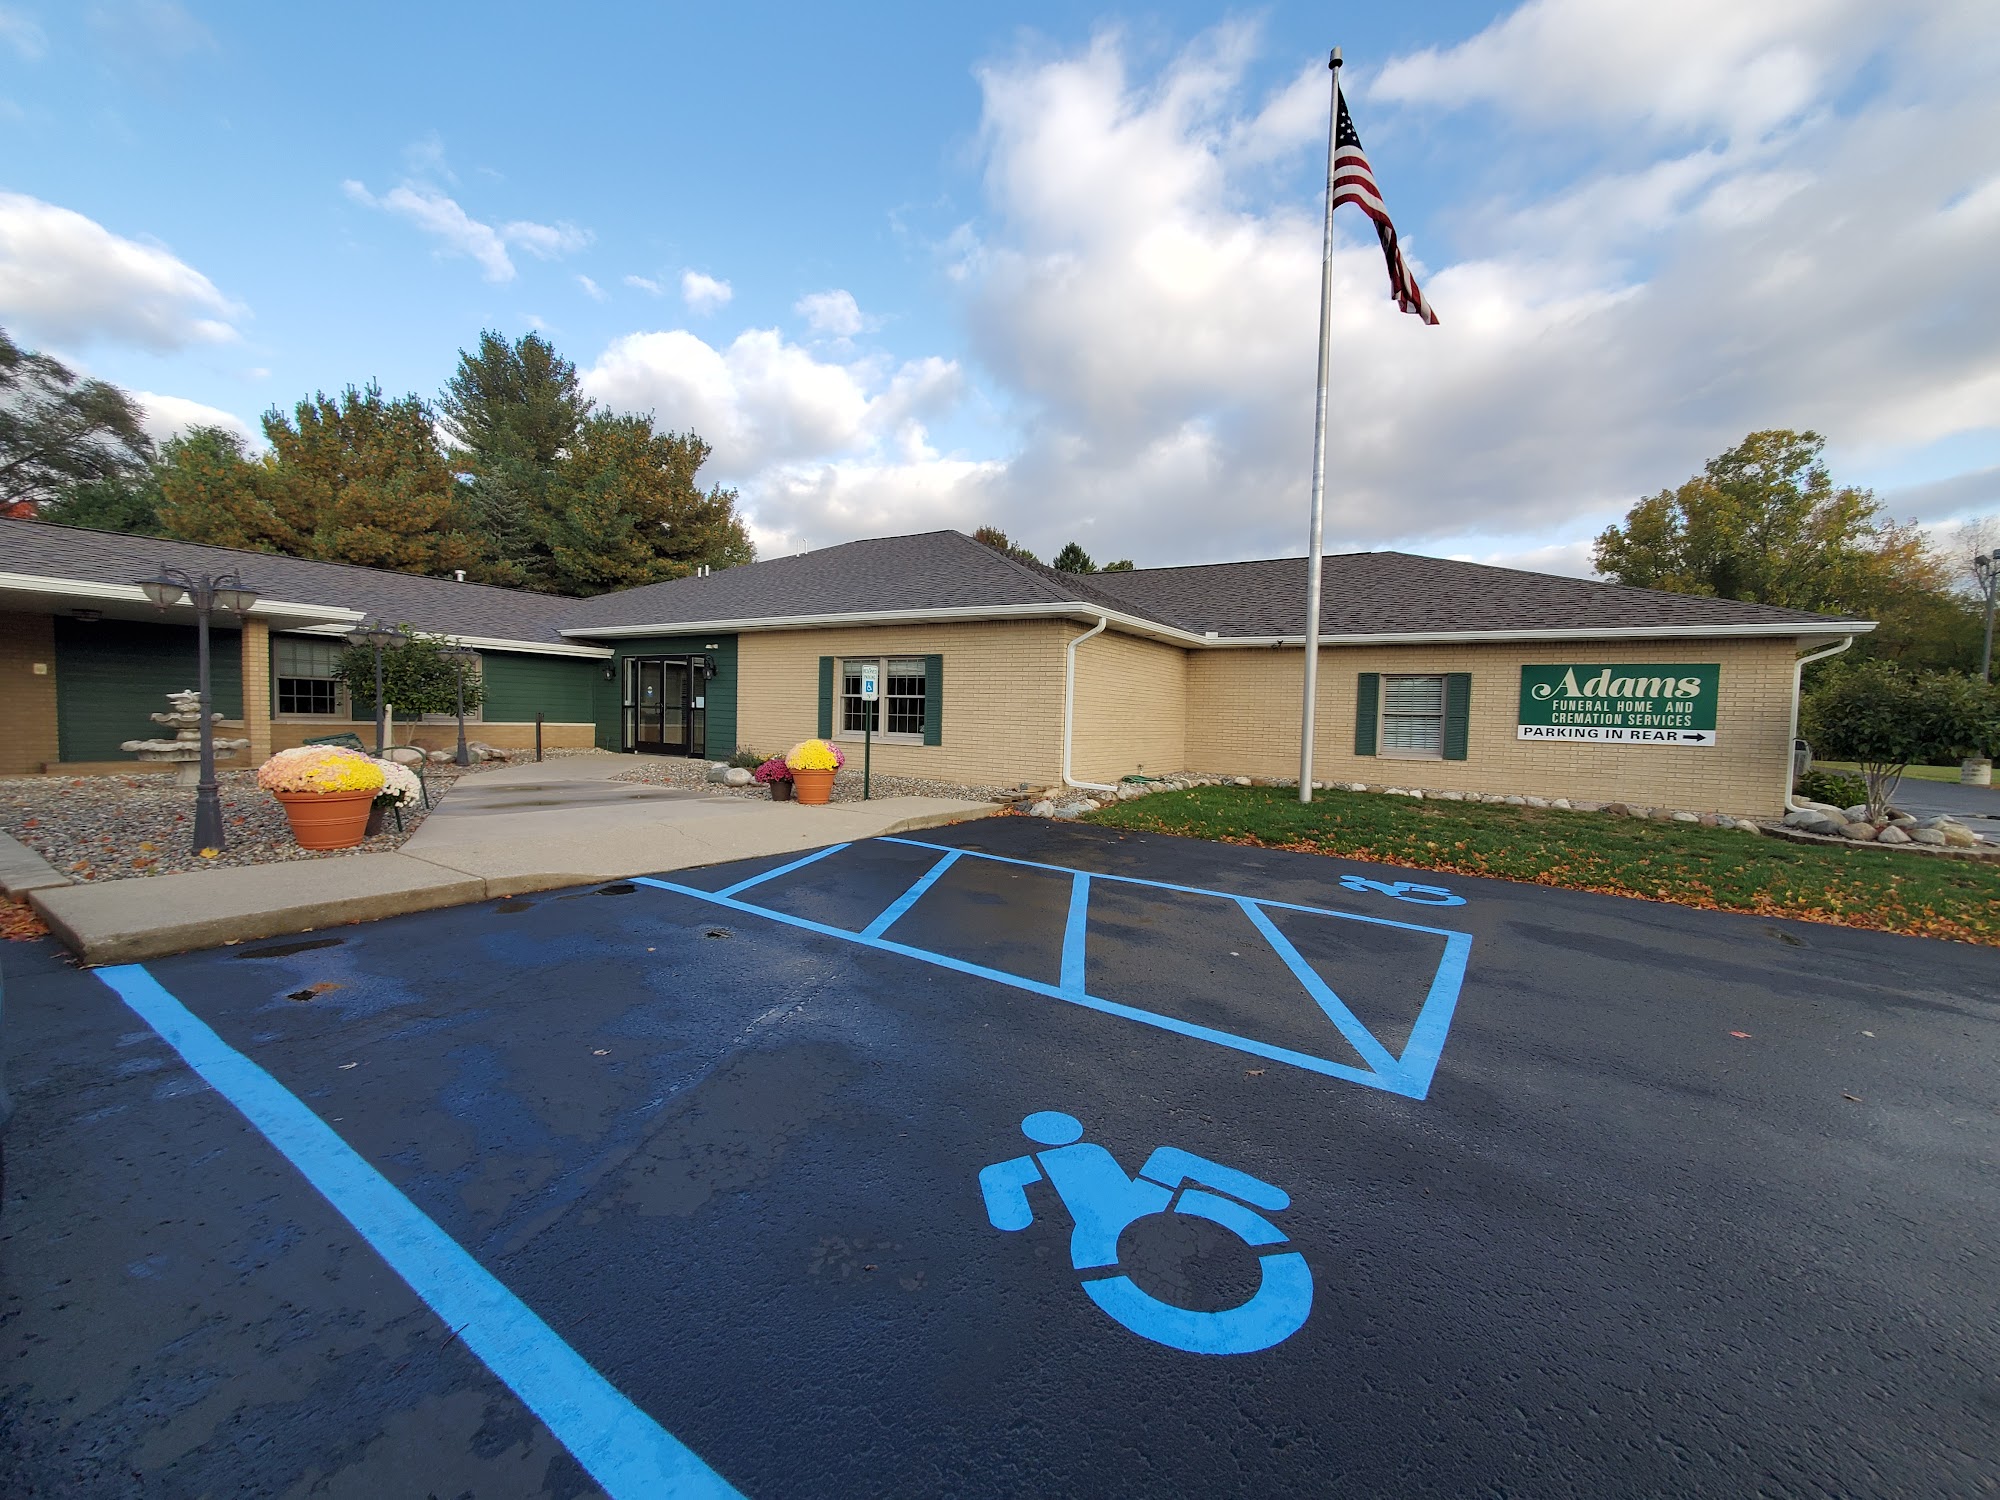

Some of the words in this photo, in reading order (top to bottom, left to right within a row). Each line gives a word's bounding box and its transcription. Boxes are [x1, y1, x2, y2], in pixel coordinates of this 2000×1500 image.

[1531, 666, 1701, 700] Adams
[1552, 700, 1610, 712] FUNERAL
[1617, 701, 1653, 713] HOME
[1665, 701, 1693, 713] AND
[1551, 713, 1622, 725] CREMATION
[1628, 714, 1692, 727] SERVICES
[1524, 727, 1599, 738] PARKING
[1605, 729, 1623, 739] IN
[1630, 730, 1678, 741] REAR
